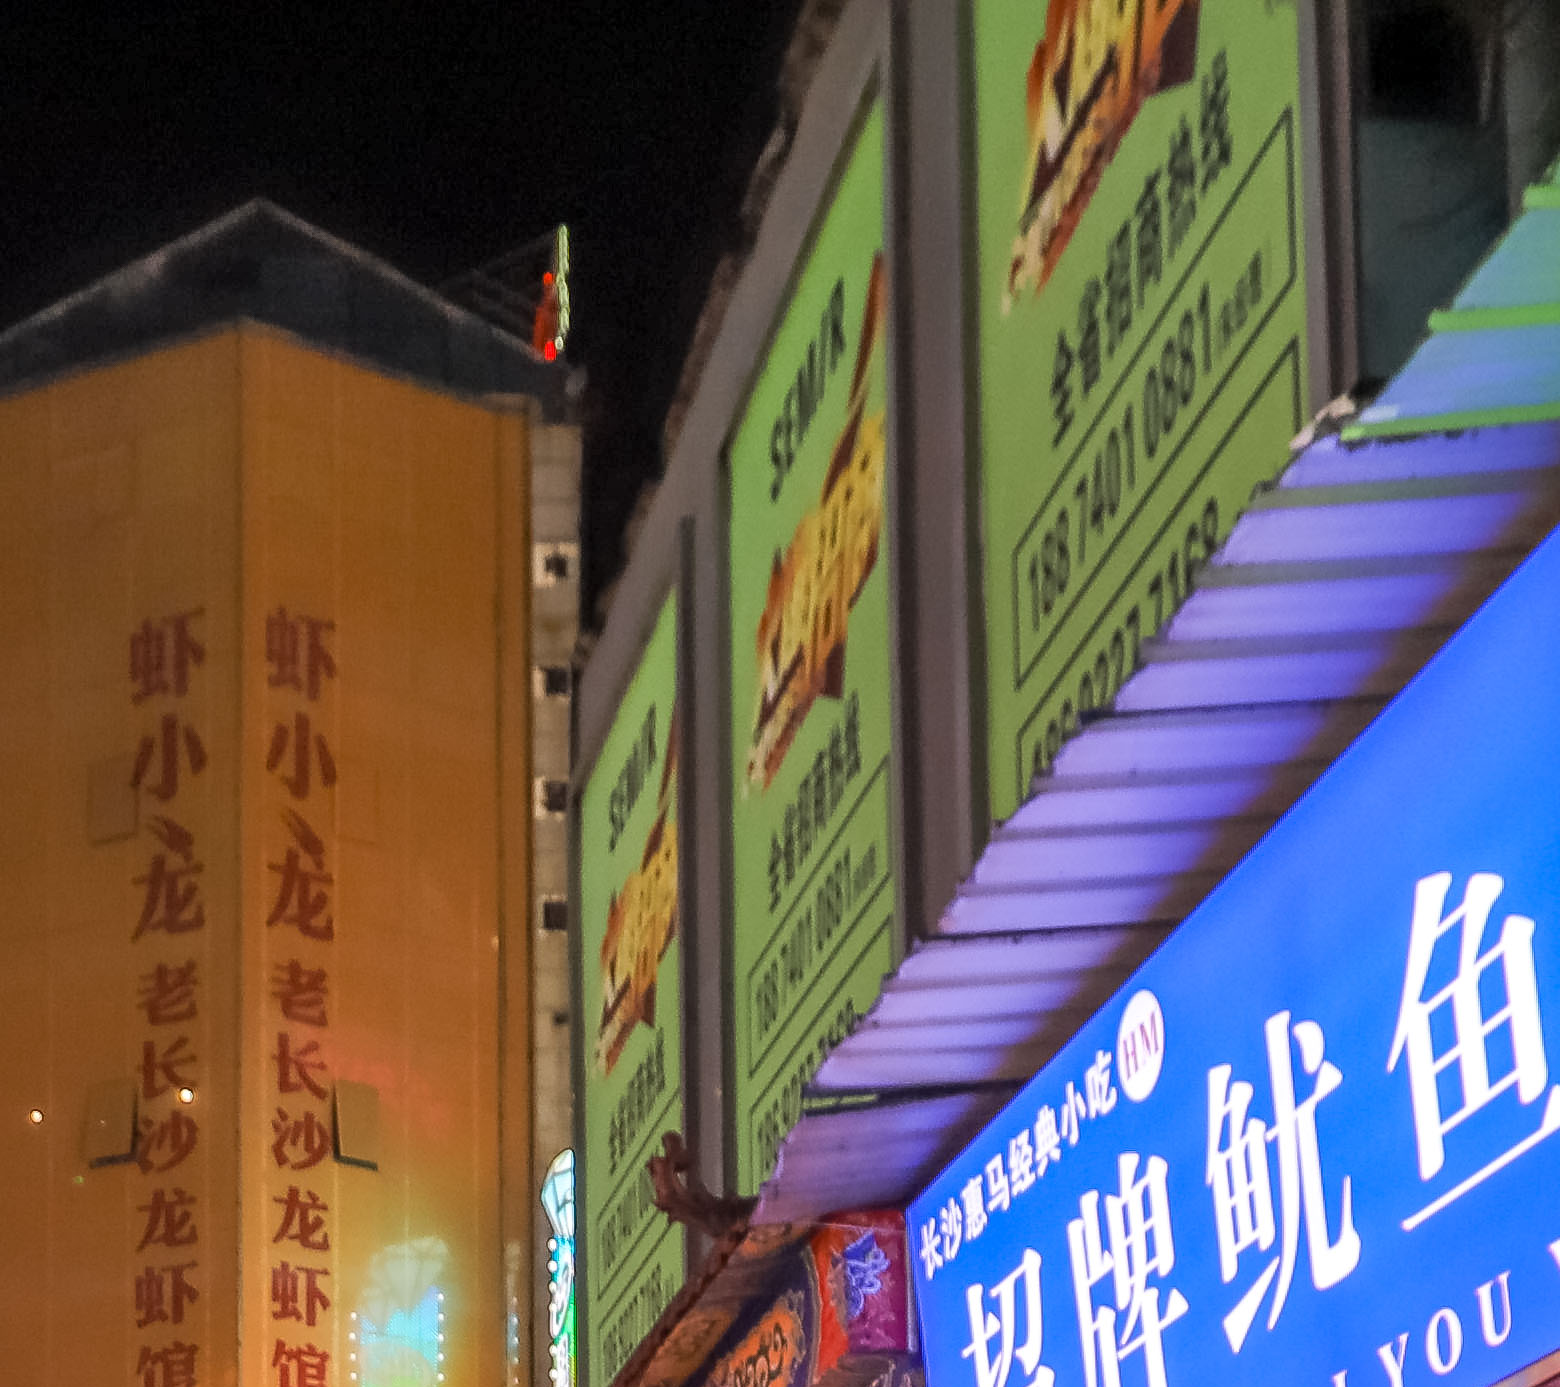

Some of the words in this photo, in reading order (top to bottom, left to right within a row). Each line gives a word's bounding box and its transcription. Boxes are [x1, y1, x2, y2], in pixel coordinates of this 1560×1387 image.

[1122, 1012, 1160, 1080] HM
[917, 1050, 1120, 1283] 长沙惠马经典小吃
